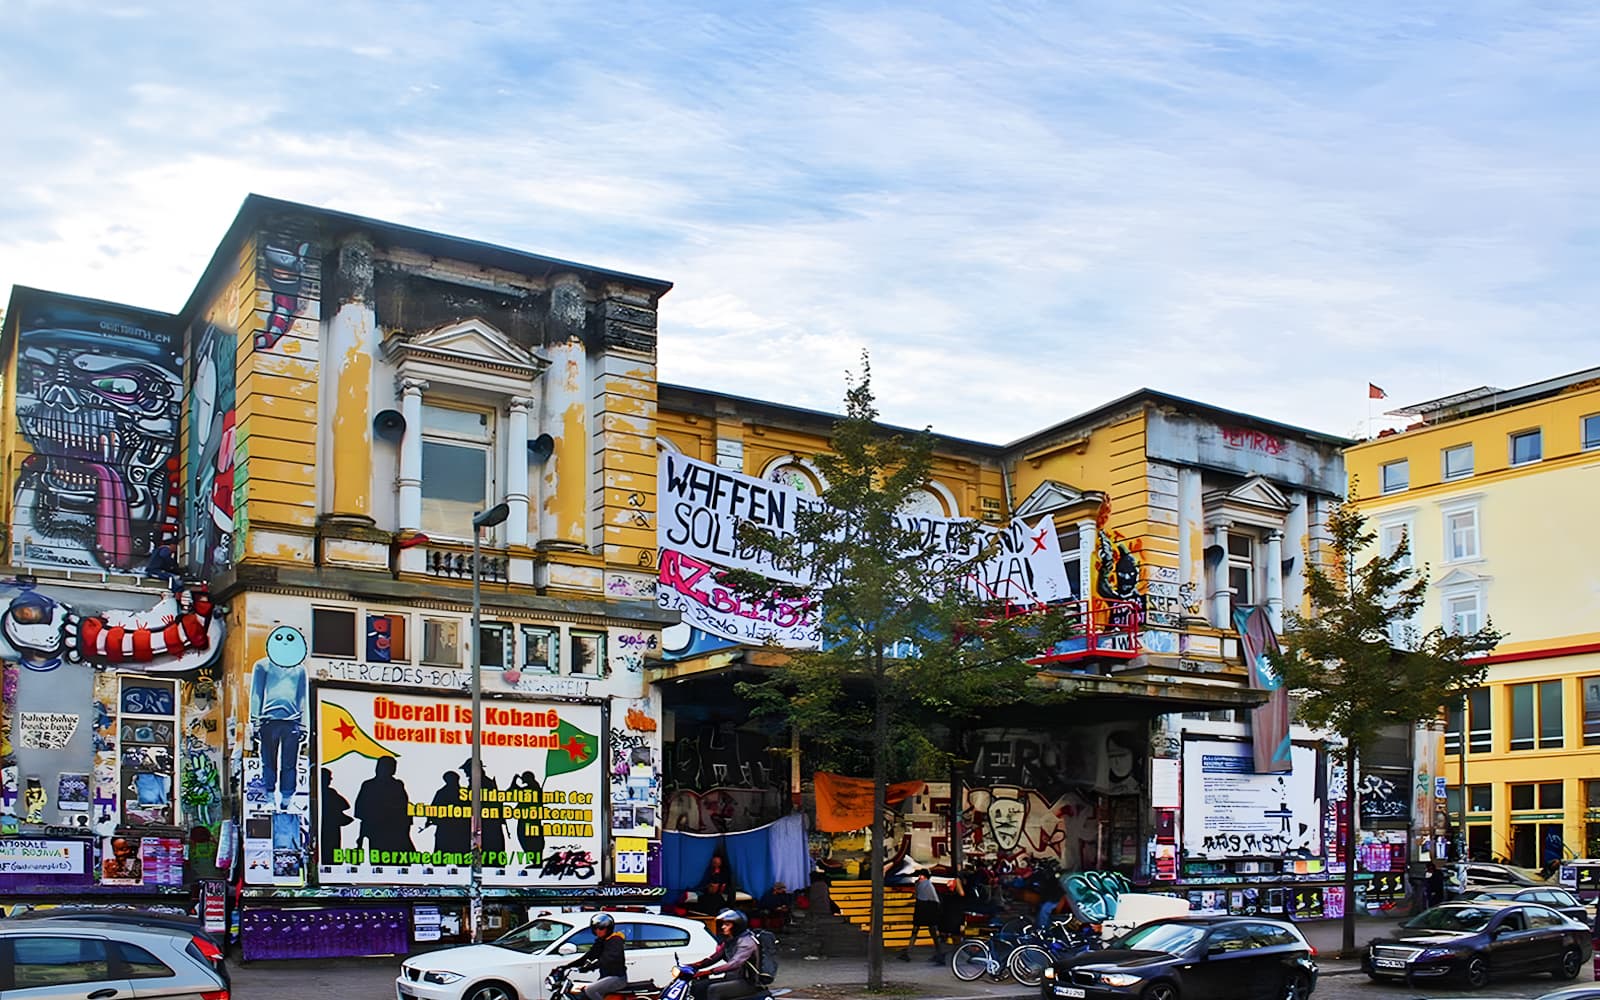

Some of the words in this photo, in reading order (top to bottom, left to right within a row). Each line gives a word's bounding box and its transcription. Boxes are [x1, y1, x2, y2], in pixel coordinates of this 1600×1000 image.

[667, 455, 786, 529] WAFFEN
[374, 696, 449, 722] Überall
[455, 706, 473, 724] is
[485, 708, 559, 728] Kobanê
[374, 722, 436, 743] Überall
[440, 728, 462, 744] ist
[542, 791, 566, 804] mit
[569, 791, 593, 804] der
[407, 802, 499, 819] kämpfenen
[503, 805, 593, 822] Bevölkerung
[525, 822, 539, 836] in
[543, 823, 593, 837] ROJAVA
[370, 849, 472, 866] Berxwedana
